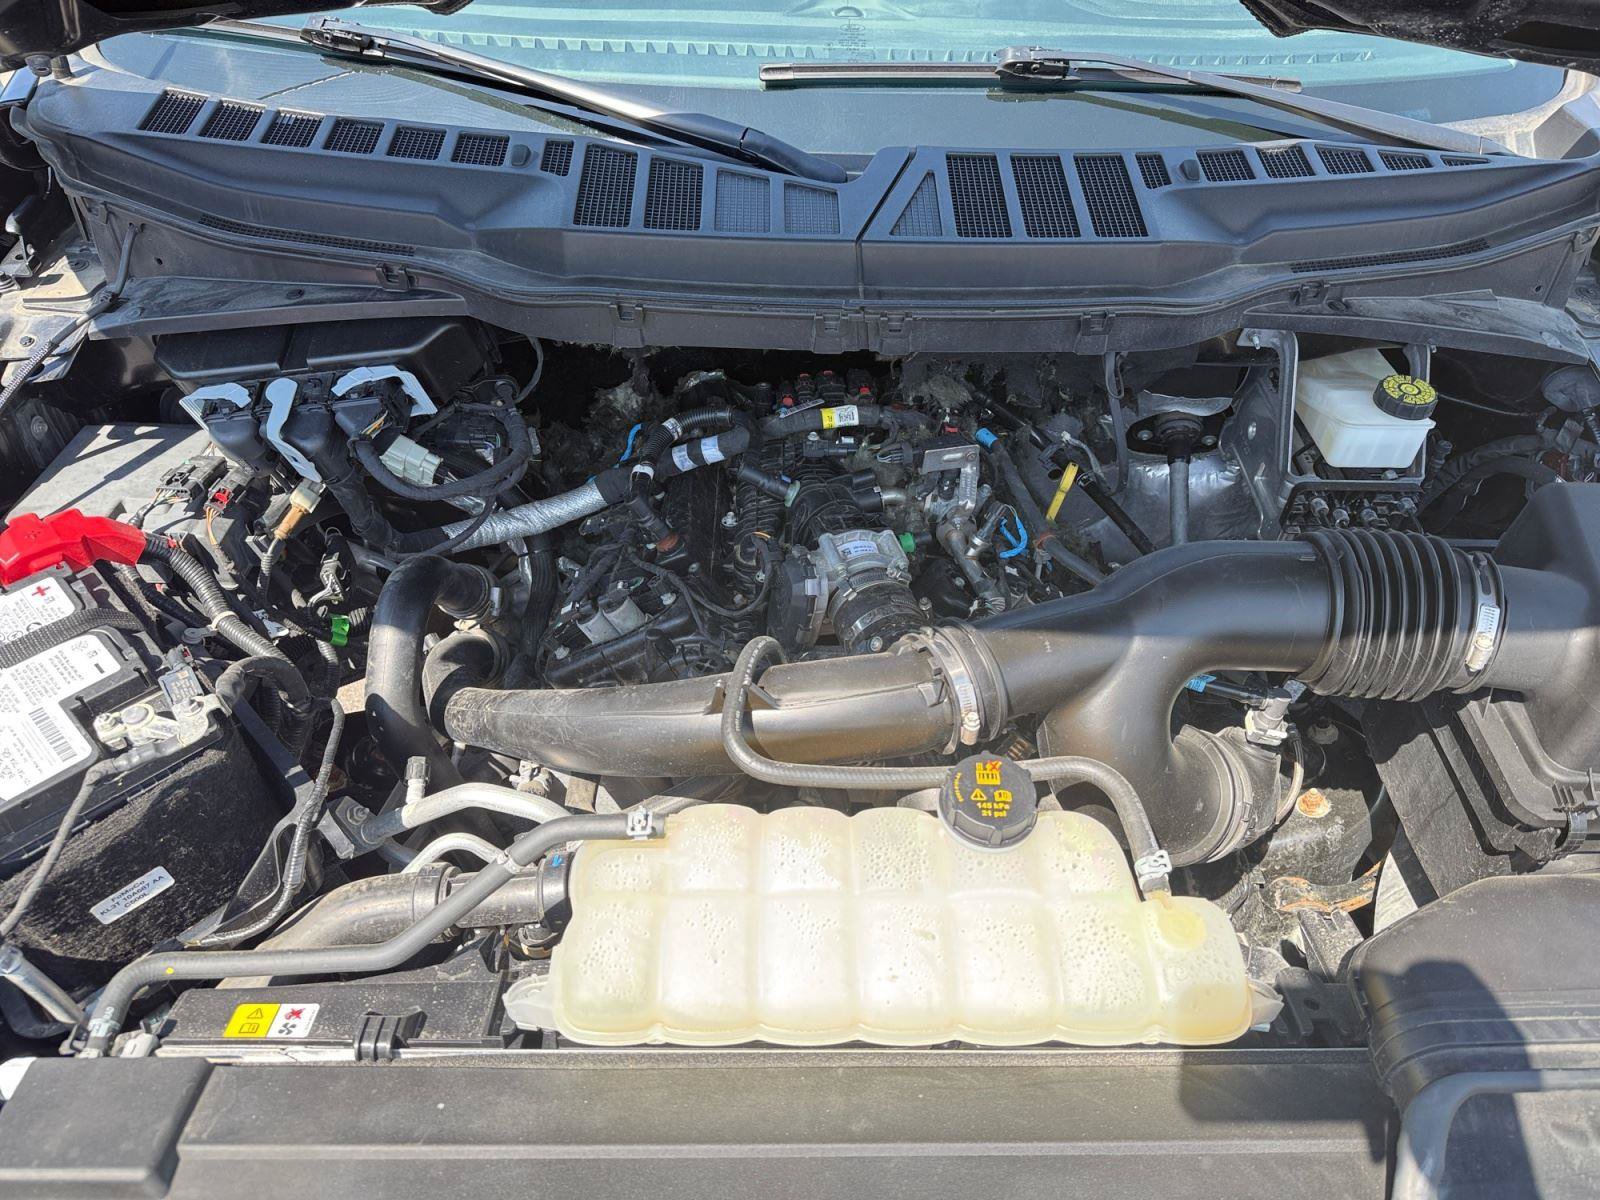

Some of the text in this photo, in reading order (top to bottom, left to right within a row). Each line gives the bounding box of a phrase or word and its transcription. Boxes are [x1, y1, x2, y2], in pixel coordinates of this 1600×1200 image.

[100, 901, 121, 916] KL3T
[152, 875, 165, 885] AA
[111, 880, 145, 903] FoMoCo
